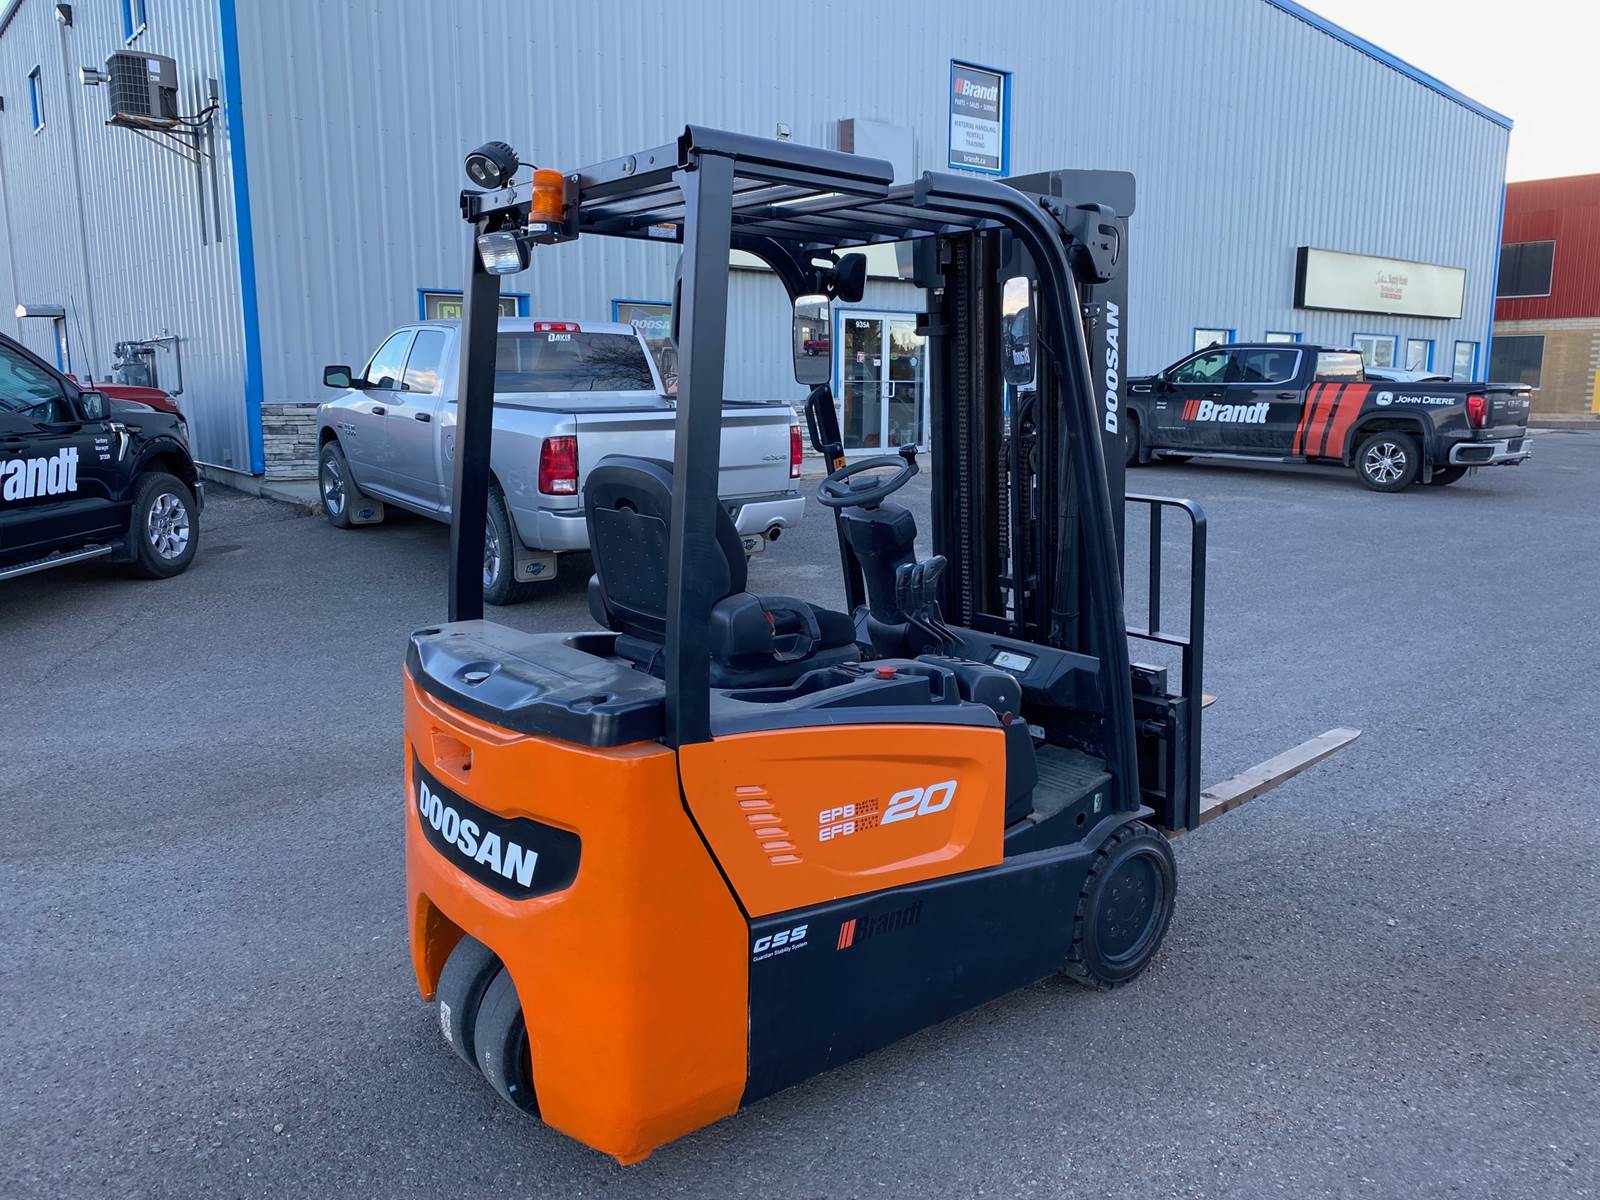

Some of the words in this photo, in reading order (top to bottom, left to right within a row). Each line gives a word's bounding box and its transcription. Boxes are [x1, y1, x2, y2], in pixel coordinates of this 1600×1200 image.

[962, 79, 998, 101] Brandt
[954, 120, 974, 129] MATERIAL
[963, 154, 986, 165] brandt.ca
[1105, 301, 1120, 434] DOOSAN
[1395, 394, 1421, 404] JOHN
[1422, 396, 1456, 406] DEERE
[1196, 400, 1270, 424] Brandt
[0, 447, 79, 501] randt
[819, 803, 856, 824] EPB
[880, 779, 957, 825] 20
[419, 780, 538, 887] DOOSAN
[818, 821, 856, 842] EFB
[858, 901, 922, 942] Brandt
[753, 924, 809, 954] GSS
[752, 952, 774, 962] Guardian
[774, 946, 791, 956] Stability
[791, 941, 808, 951] System
